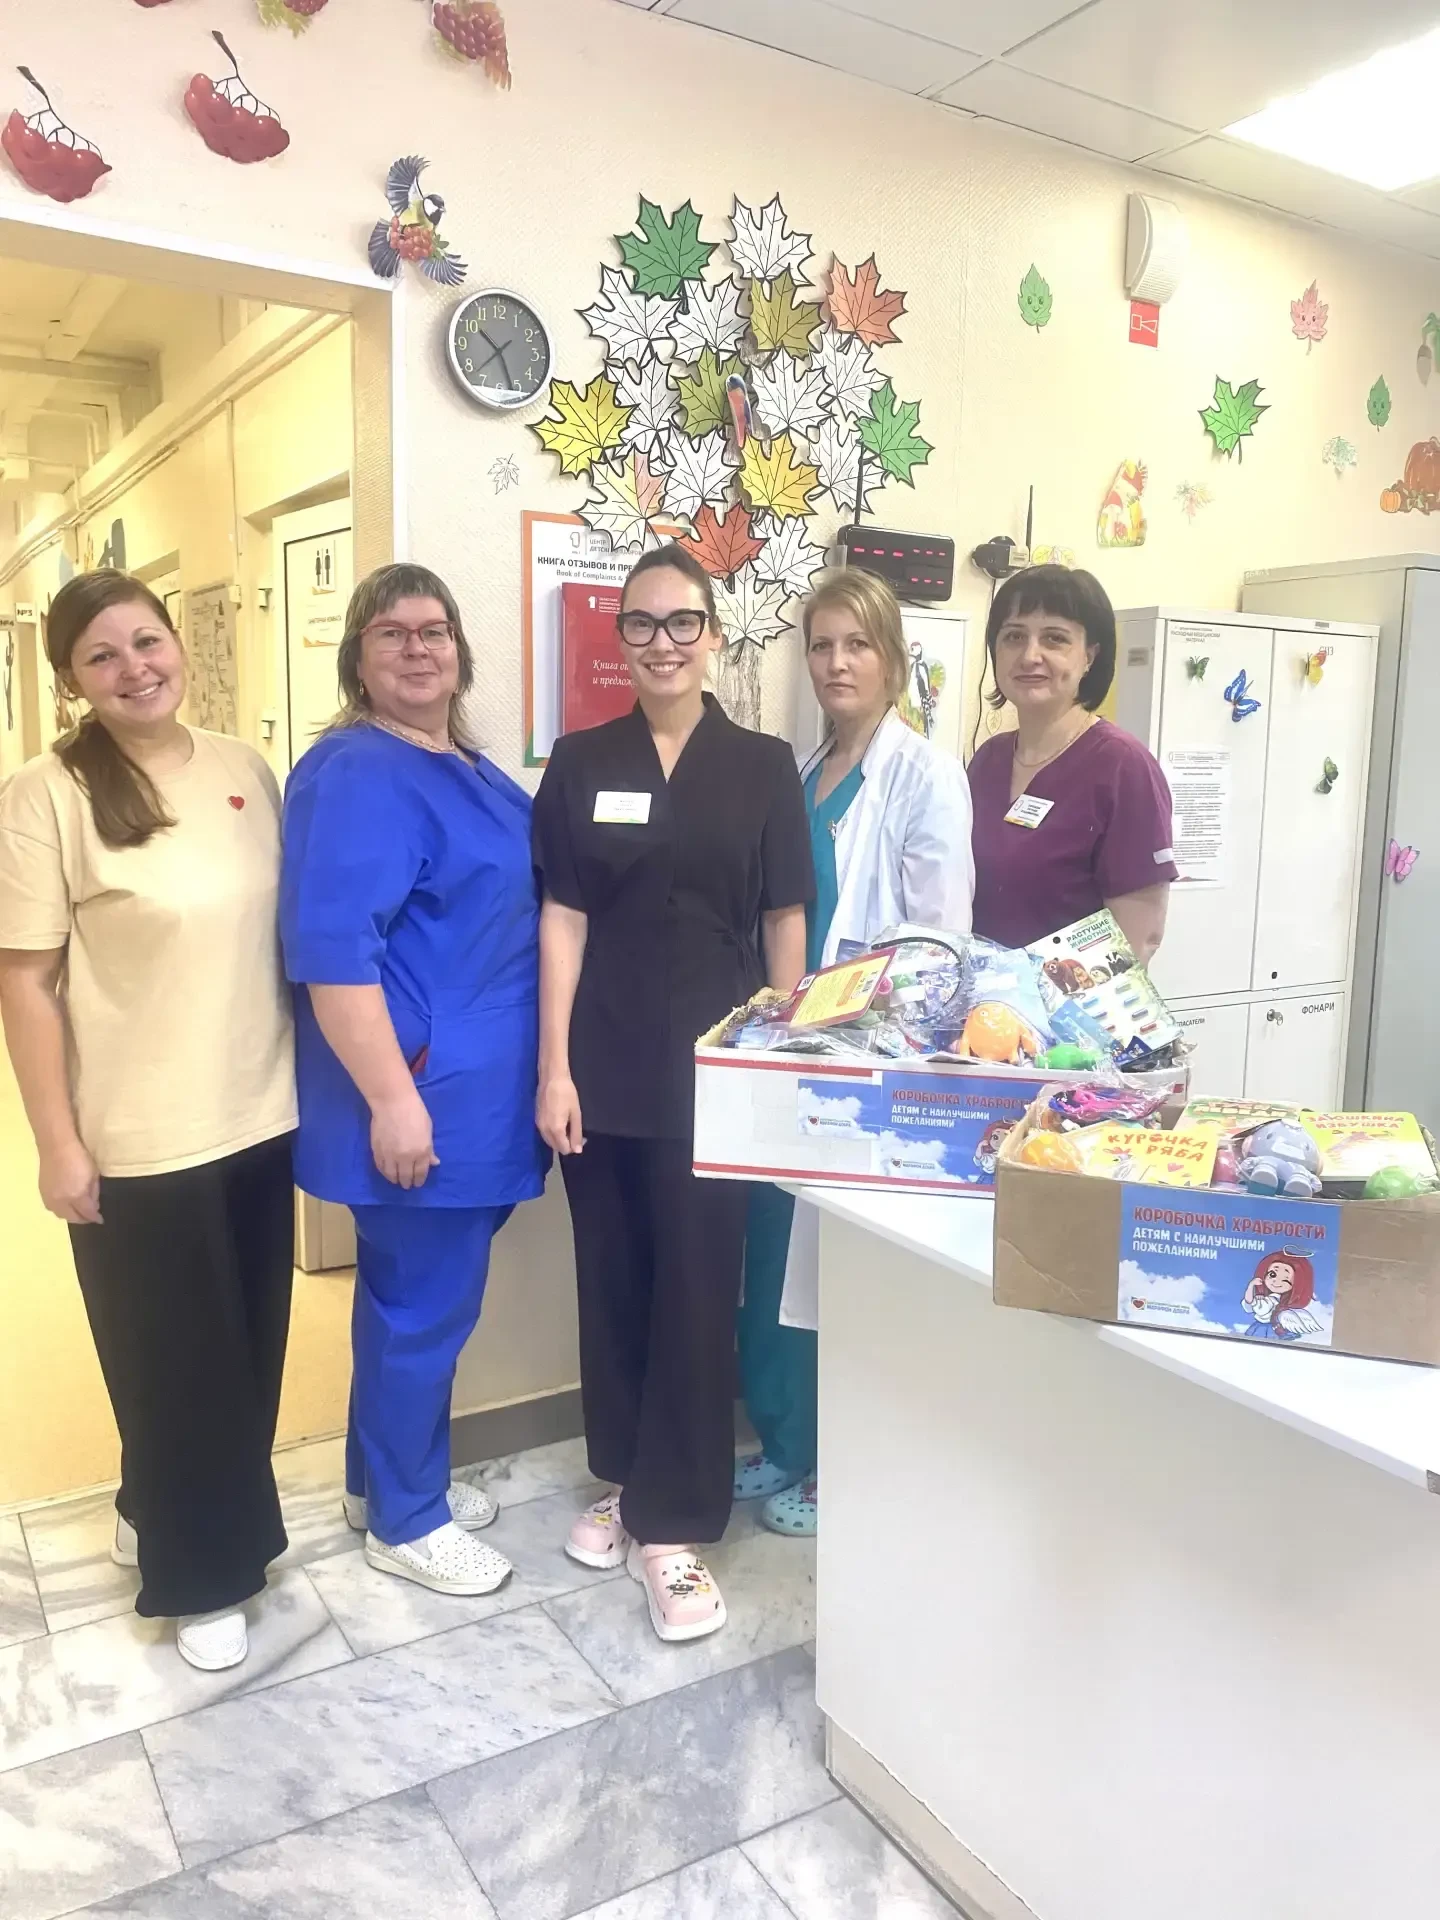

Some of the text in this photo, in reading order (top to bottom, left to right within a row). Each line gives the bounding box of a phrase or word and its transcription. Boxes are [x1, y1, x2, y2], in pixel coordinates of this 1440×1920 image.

[477, 307, 487, 320] 11
[493, 305, 506, 319] 12
[465, 319, 478, 333] 10
[513, 314, 518, 327] 1
[524, 328, 533, 342] 2
[458, 336, 467, 350] 9
[530, 347, 539, 361] 3
[464, 358, 473, 372] 8
[479, 374, 487, 386] 7
[524, 366, 532, 380] 4
[513, 380, 522, 391] 5
[537, 556, 633, 571] КНИГА ОТЗЫВОВ И ПРЕ
[556, 569, 572, 577] Book
[582, 572, 616, 581] Complaints
[592, 659, 618, 671] Книга
[1066, 918, 1110, 942] РАСТУЩИЕ
[1070, 925, 1113, 948] ЖИВОТНЫЕ
[1302, 1002, 1335, 1014] ФОНАРИ
[1176, 1017, 1205, 1028] ПАСАТЕЛИ
[892, 1089, 960, 1105] КОРОБОЧКА
[891, 1104, 990, 1120] ДЕТЯМ С НАИЛУЧШИМИ
[1307, 1113, 1405, 1122] ЗАЮШКИНА
[891, 1115, 955, 1128] ПОЖЕЛАНИЯМИ
[1315, 1121, 1400, 1129] ИЗБУШКА
[1107, 1133, 1208, 1149] КУРОЧКА
[1146, 1144, 1205, 1162] РЯБА
[1133, 1206, 1326, 1240] КОРОБОЧКА ХРАБРОСТИ
[1133, 1226, 1265, 1251] ДЕТЯМ С НАИЛУЧШИМИ
[1132, 1240, 1218, 1260] ПОЖЕЛАНИЯМИ
